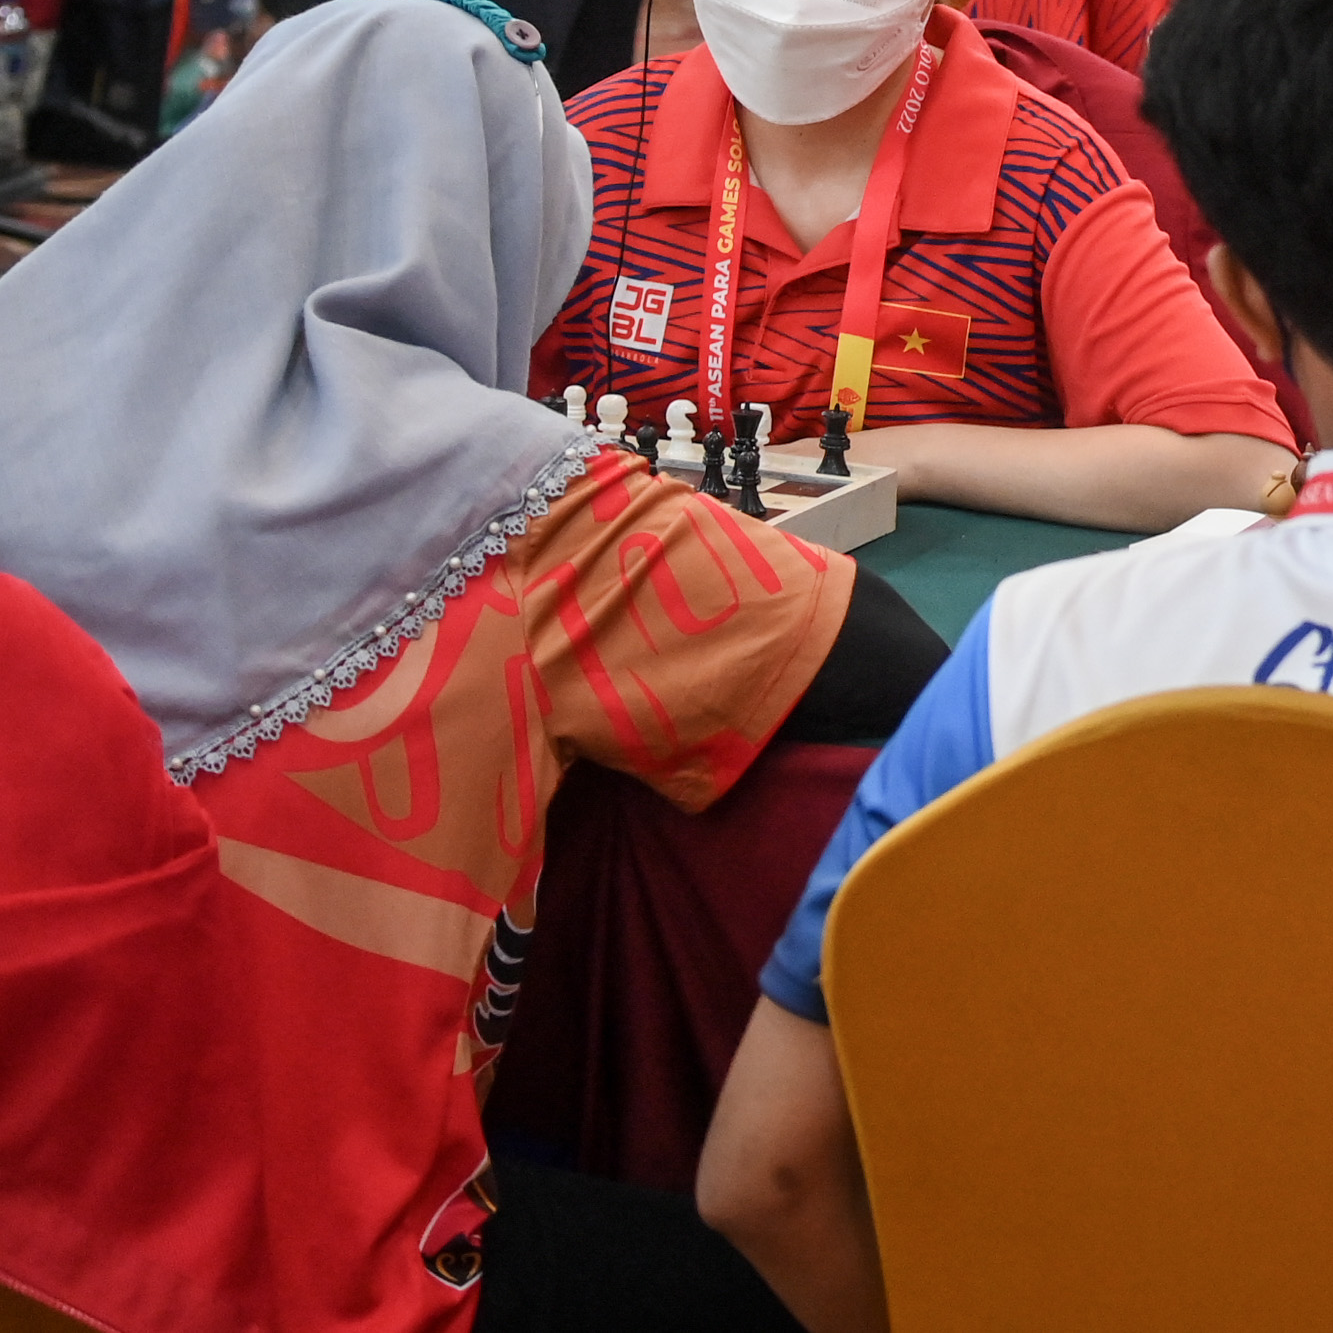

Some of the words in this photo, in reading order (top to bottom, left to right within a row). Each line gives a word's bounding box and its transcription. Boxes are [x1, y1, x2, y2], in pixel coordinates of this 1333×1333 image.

[896, 87, 926, 134] 2022
[716, 176, 742, 254] GAMES
[710, 259, 732, 320] PARA
[707, 323, 726, 379] ASEAN
